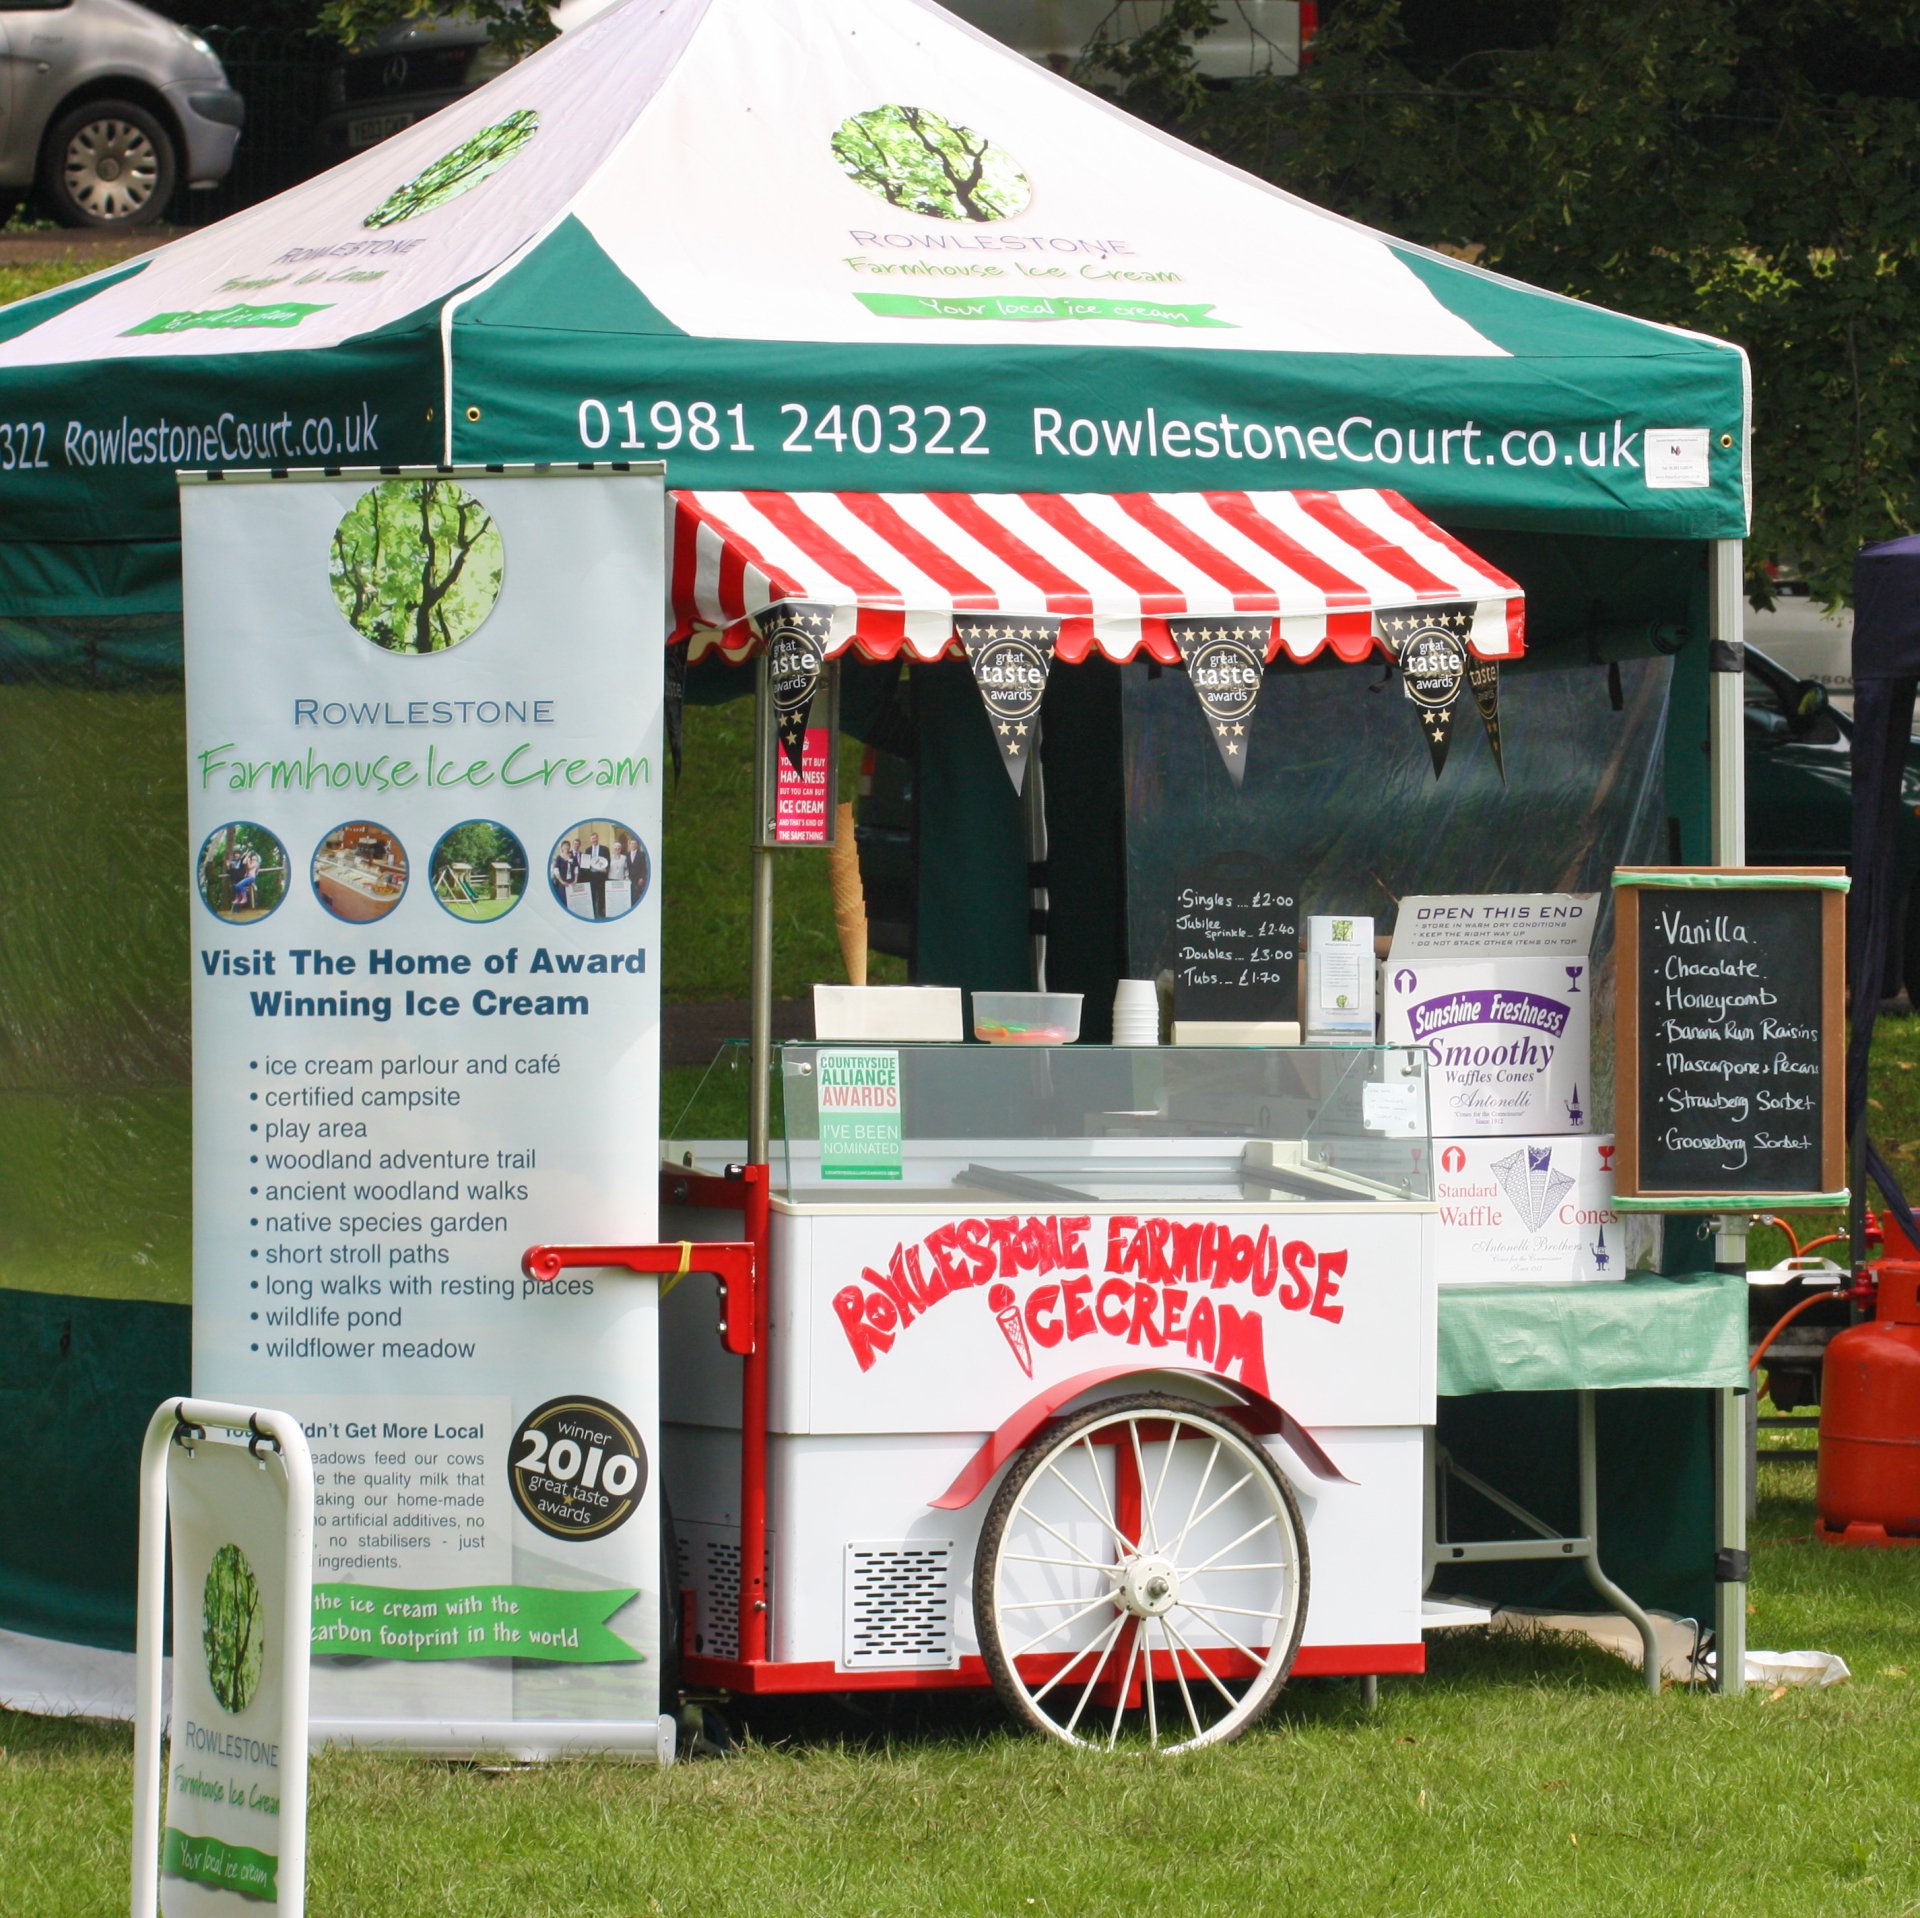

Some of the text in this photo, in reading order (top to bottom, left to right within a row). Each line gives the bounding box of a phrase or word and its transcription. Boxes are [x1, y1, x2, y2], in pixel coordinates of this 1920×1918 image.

[849, 230, 1136, 255] ROWLESTONE
[842, 255, 1183, 282] Farmhouse Ice Cream
[918, 299, 1191, 322] Your local ice cream
[65, 401, 379, 466] RowlestoneCourt.co.uk
[578, 398, 1641, 468] 01981 240322 RowlestoneCourt.co.uk
[1419, 639, 1445, 655] great
[995, 652, 1025, 667] great
[1210, 653, 1238, 668] great
[1407, 653, 1460, 673] taste
[981, 664, 1042, 683] taste
[1196, 666, 1257, 685] taste
[1416, 676, 1454, 690] awards
[990, 688, 1033, 702] awards
[1207, 690, 1248, 702] awards
[294, 698, 555, 726] ROWLESTONE
[197, 743, 651, 791] Farmhouse Ice Cream
[780, 800, 824, 813] ICE CREAM
[1252, 891, 1294, 908] £2.00
[1176, 914, 1221, 930] Jubilee
[1417, 906, 1583, 920] OPEN THIS END
[1258, 921, 1295, 937] £2.40
[200, 947, 646, 976] Visit The Home of Award
[1250, 947, 1293, 962] £3.00
[249, 989, 589, 1023] Winning Ice Cream
[1415, 993, 1563, 1035] Sunshine Freshness
[1666, 986, 1778, 1023] Honeycomb
[1663, 1018, 1818, 1043] Banana Rum Raisins
[820, 1056, 896, 1069] COUNTRYSIDE
[1427, 1036, 1555, 1073] Smoothy
[265, 1053, 561, 1080] ice cream parlour and café
[1666, 1052, 1819, 1081] Mascarpone Pecans
[822, 1069, 896, 1086] ALLIANCE
[1446, 1070, 1535, 1086] Waffles Cones
[265, 1086, 461, 1111] certified campsite
[823, 1086, 897, 1107] AWARDS
[1449, 1089, 1532, 1108] Antonelli
[1756, 1090, 1816, 1111] Sorbet
[265, 1118, 368, 1143] play area
[823, 1125, 898, 1139] I'VE BEEN
[1753, 1132, 1813, 1150] Sorbet
[824, 1142, 899, 1154] NOMINATED
[265, 1148, 536, 1170] woodland adventure trail
[265, 1180, 529, 1201] ancient woodland walks
[1438, 1184, 1497, 1198] Standard
[266, 1211, 508, 1238] native species garden
[1439, 1204, 1618, 1226] Waffle Cones
[265, 1243, 450, 1268] short stroll paths
[266, 1275, 313, 1301] long
[320, 1274, 382, 1295] walks
[389, 1275, 432, 1295] with
[441, 1275, 515, 1301] resting
[833, 1216, 1348, 1373] ROWLESTONE FARMHOUSE
[265, 1305, 402, 1332] wildlife pond
[266, 1337, 476, 1359] wildflower meadow
[345, 1422, 484, 1439] Get More Local
[558, 1421, 612, 1445] winner
[374, 1450, 485, 1466] feed our cows
[514, 1429, 638, 1496] 2010
[333, 1471, 485, 1489] the quality milk that
[364, 1492, 485, 1507] our home-made
[528, 1475, 609, 1508] great taste
[331, 1512, 485, 1529] artificial additives, no
[538, 1498, 591, 1524] awards
[329, 1533, 485, 1551] no stabilisers just
[318, 1554, 401, 1572] ingredients.
[314, 1592, 520, 1618] the ice cream with the
[379, 1624, 459, 1653] footprint
[467, 1625, 485, 1644] in
[492, 1621, 521, 1643] the
[528, 1627, 579, 1648] world
[186, 1721, 279, 1767] ROWLESTONE
[174, 1763, 245, 1806] Farmhouse Ice
